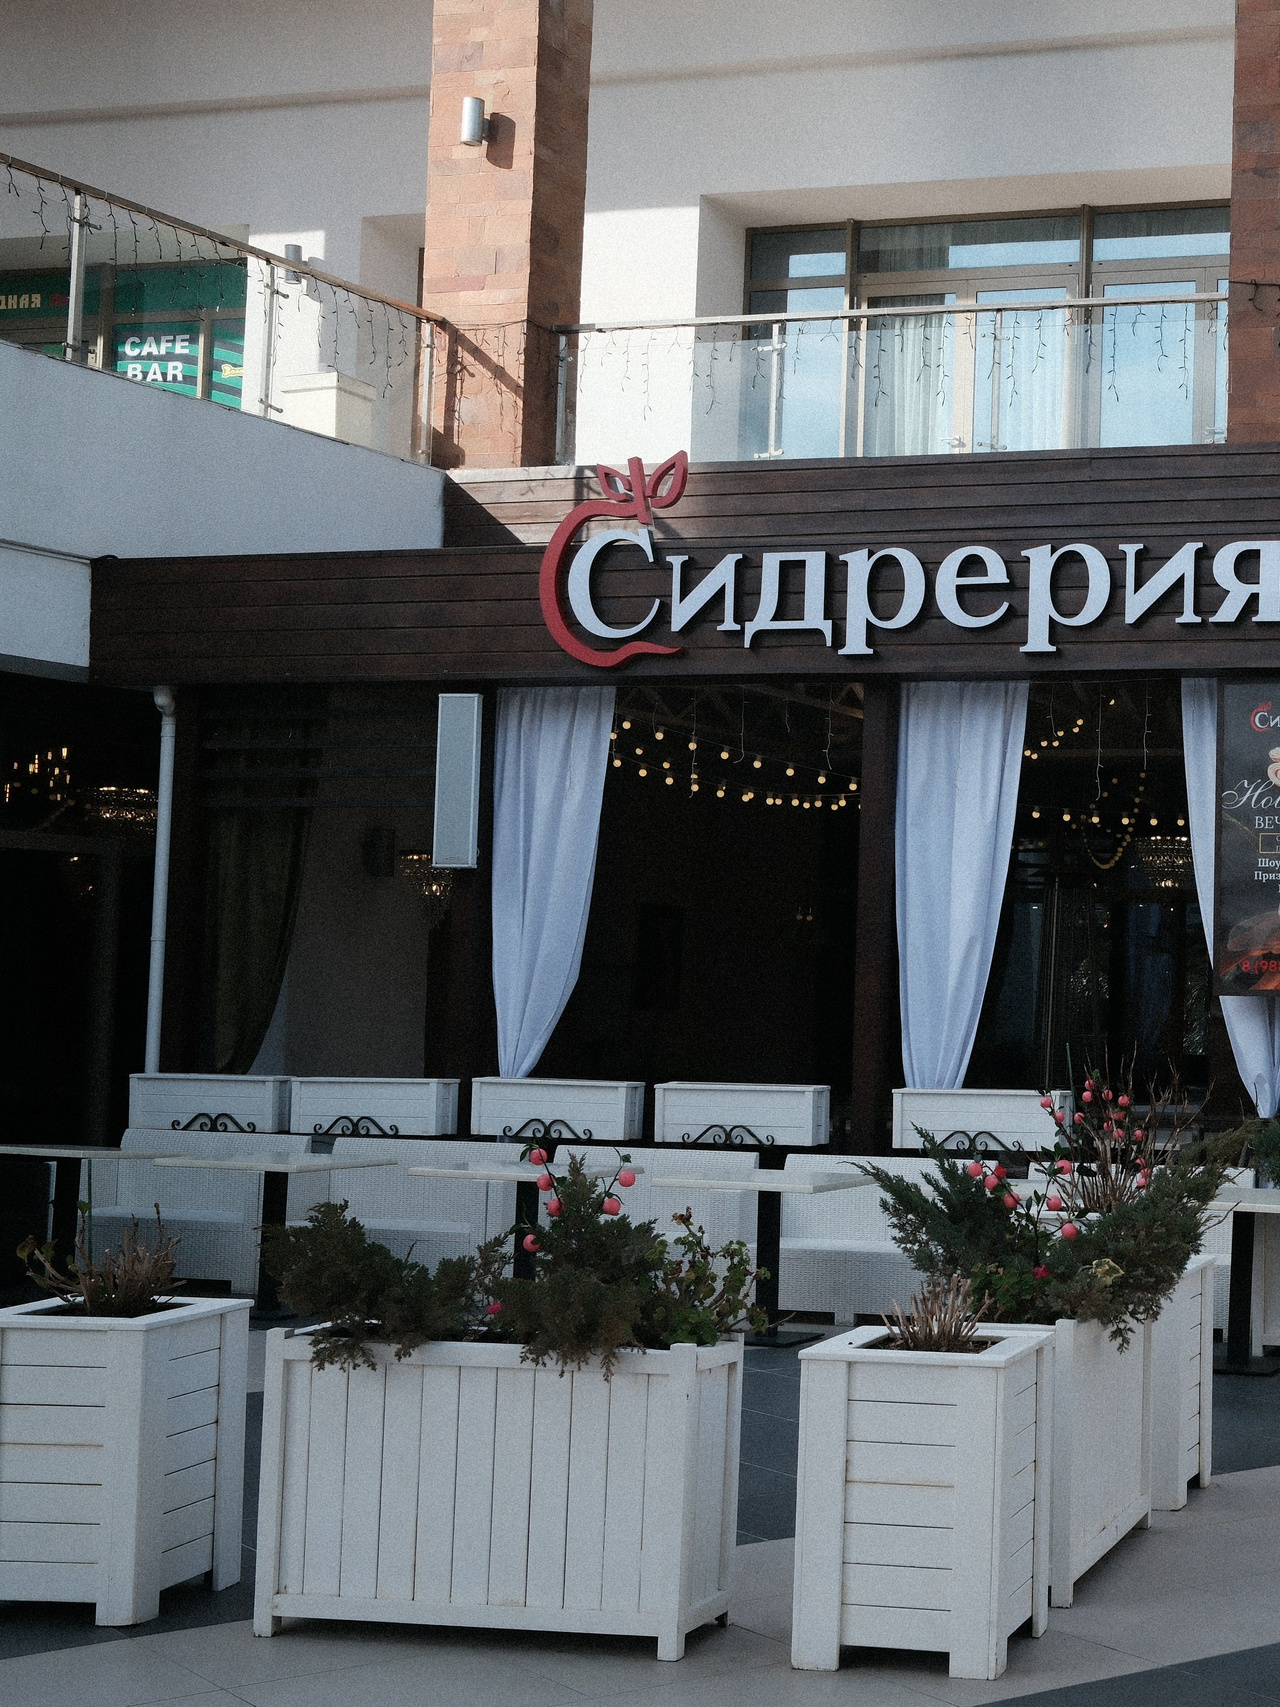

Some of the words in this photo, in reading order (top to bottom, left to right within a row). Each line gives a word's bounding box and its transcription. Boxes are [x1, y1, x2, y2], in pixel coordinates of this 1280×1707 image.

[125, 335, 190, 357] CAFE
[127, 361, 183, 382] BAR
[1241, 960, 1251, 972] 8
